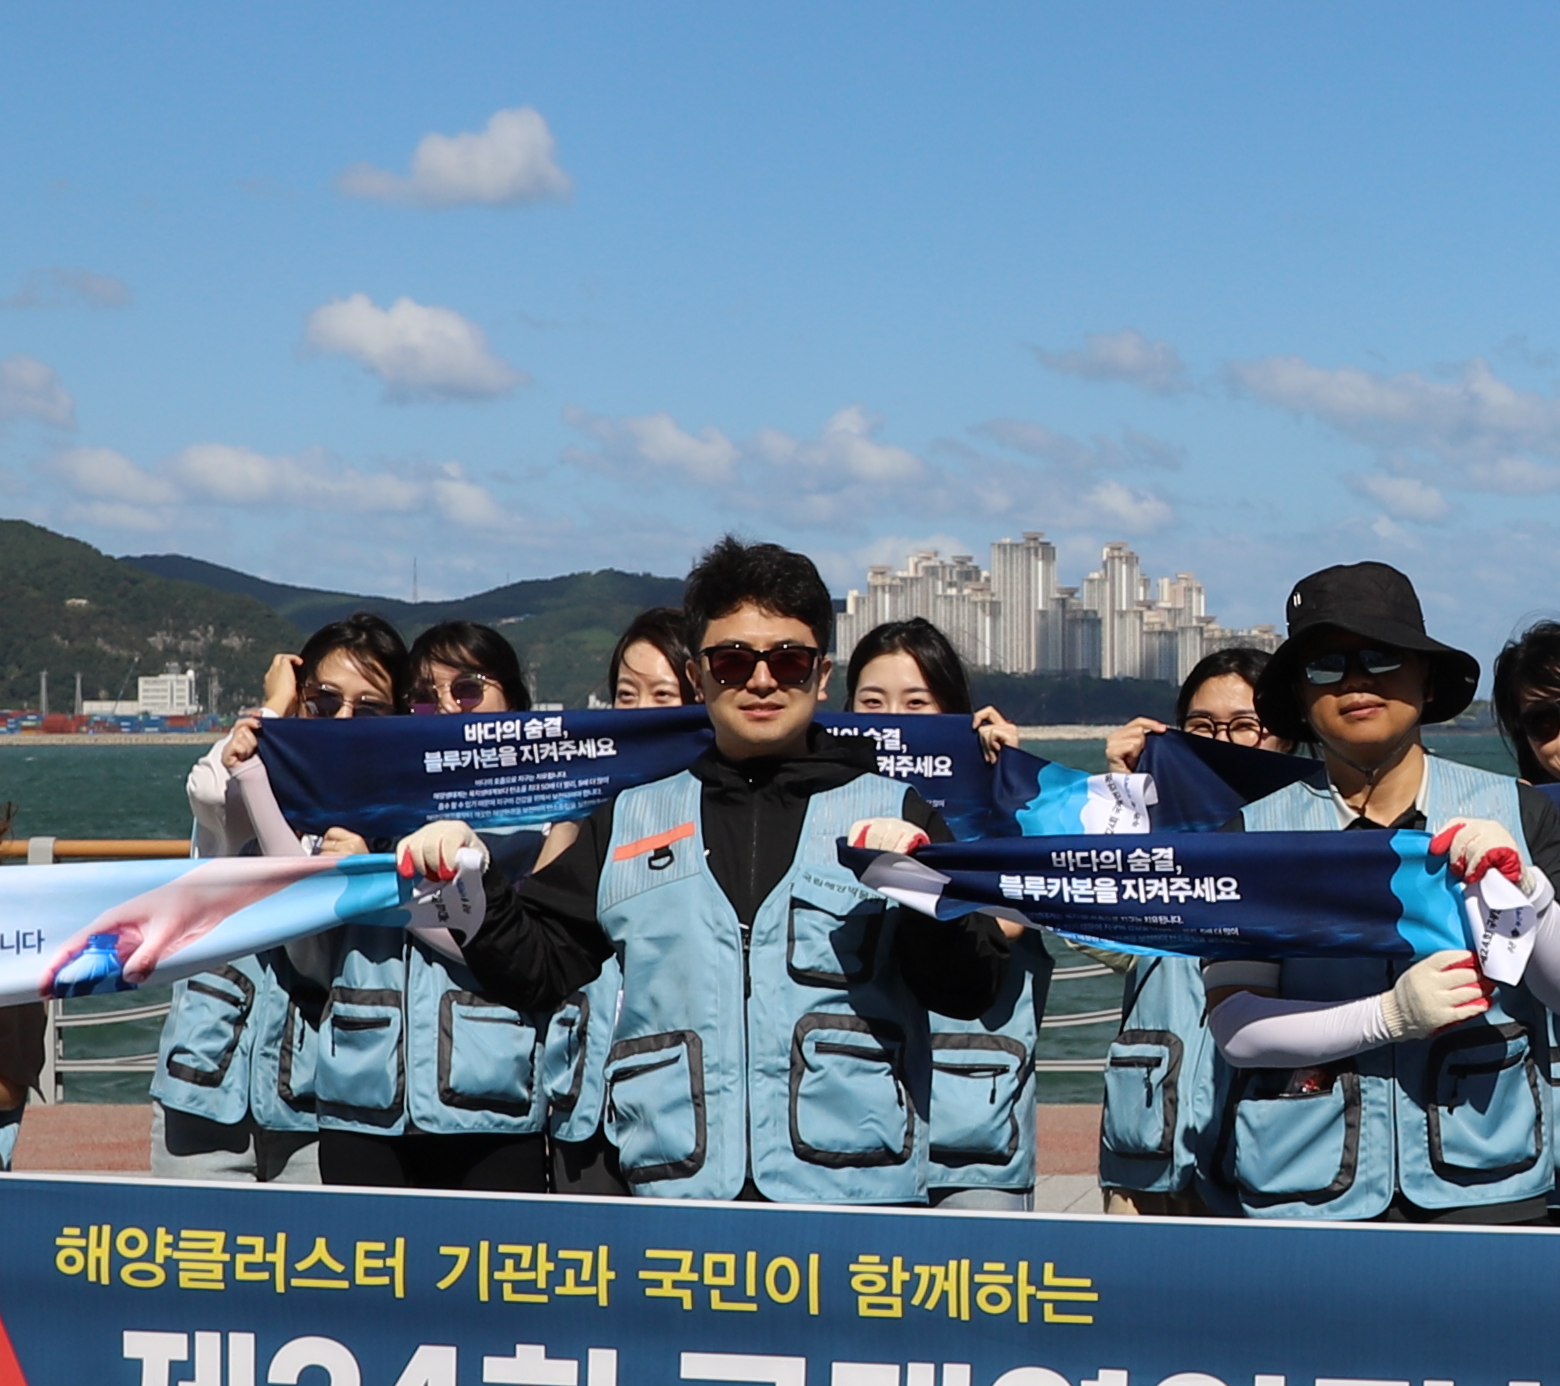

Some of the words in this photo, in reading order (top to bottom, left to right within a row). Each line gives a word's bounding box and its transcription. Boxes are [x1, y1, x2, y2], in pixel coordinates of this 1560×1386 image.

[464, 720, 521, 744] 바다의
[524, 716, 568, 739] 숨결,
[423, 746, 518, 773] 블루카본을
[520, 738, 617, 764] 지켜주세요
[876, 756, 953, 777] 켜주세요
[1051, 849, 1122, 872] 바다의
[1127, 847, 1182, 874] 숨결,
[999, 874, 1118, 904] 블루카본을
[1121, 876, 1241, 904] 지켜주세요
[54, 1224, 405, 1298] 해양클러스터
[435, 1240, 615, 1307] 기관과
[637, 1248, 819, 1315] 국민이
[848, 1254, 1100, 1325] 함께하는
